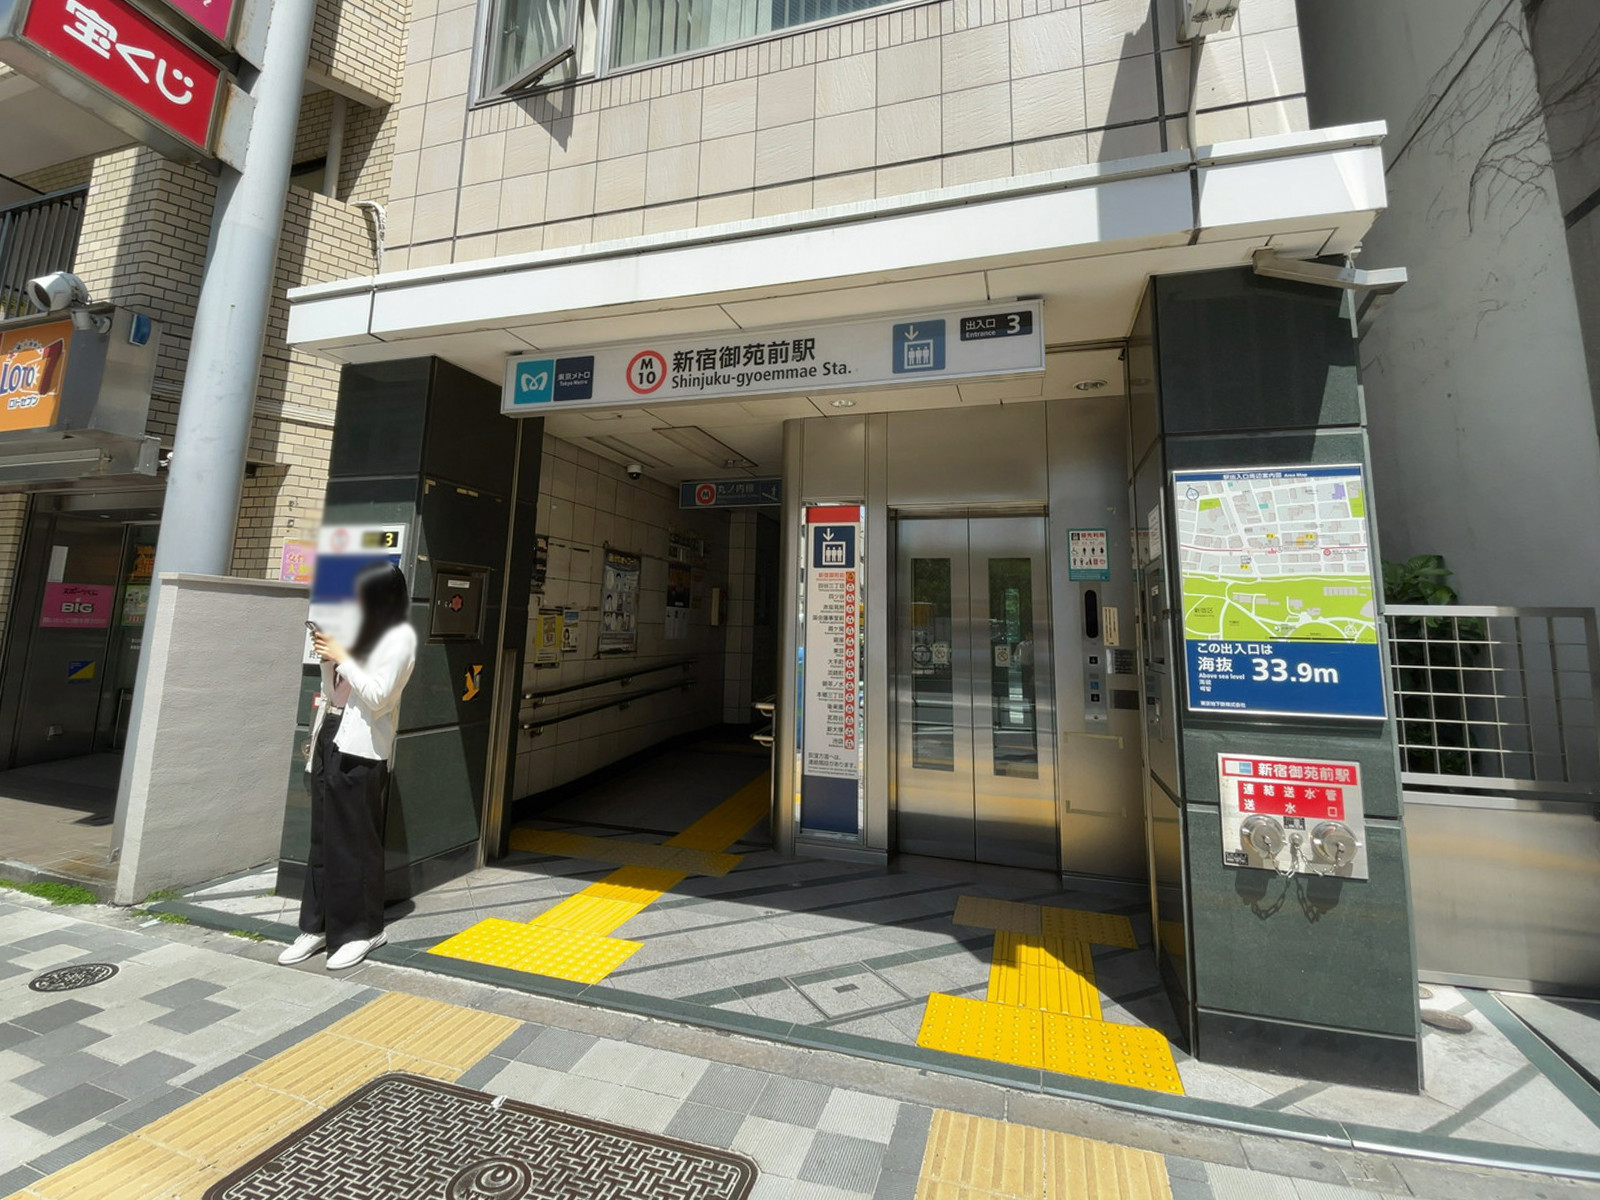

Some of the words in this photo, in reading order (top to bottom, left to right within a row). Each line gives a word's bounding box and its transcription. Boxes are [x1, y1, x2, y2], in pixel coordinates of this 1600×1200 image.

[62, 0, 195, 105] 宝くじ
[965, 318, 996, 331] 出入口
[1006, 314, 1021, 334] 3
[965, 330, 996, 339] Entrance
[640, 358, 653, 370] M
[672, 338, 816, 373] 新宿御苑前駅
[0, 363, 35, 394] LOTO
[557, 371, 591, 381] 東京メトロ
[638, 371, 656, 385] 10
[671, 365, 817, 391] Shinjuku-gyoemmae
[822, 361, 852, 376] Sta.
[8, 396, 38, 409] ロトセブン
[385, 532, 393, 547] 3
[1197, 643, 1273, 655] この出入口は
[1197, 656, 1233, 673] 海抜
[1252, 657, 1339, 684] 33.9m
[1257, 762, 1351, 783] 新宿御苑前駅
[1243, 783, 1337, 801] 連結送水管
[1243, 798, 1338, 817] 送水口
